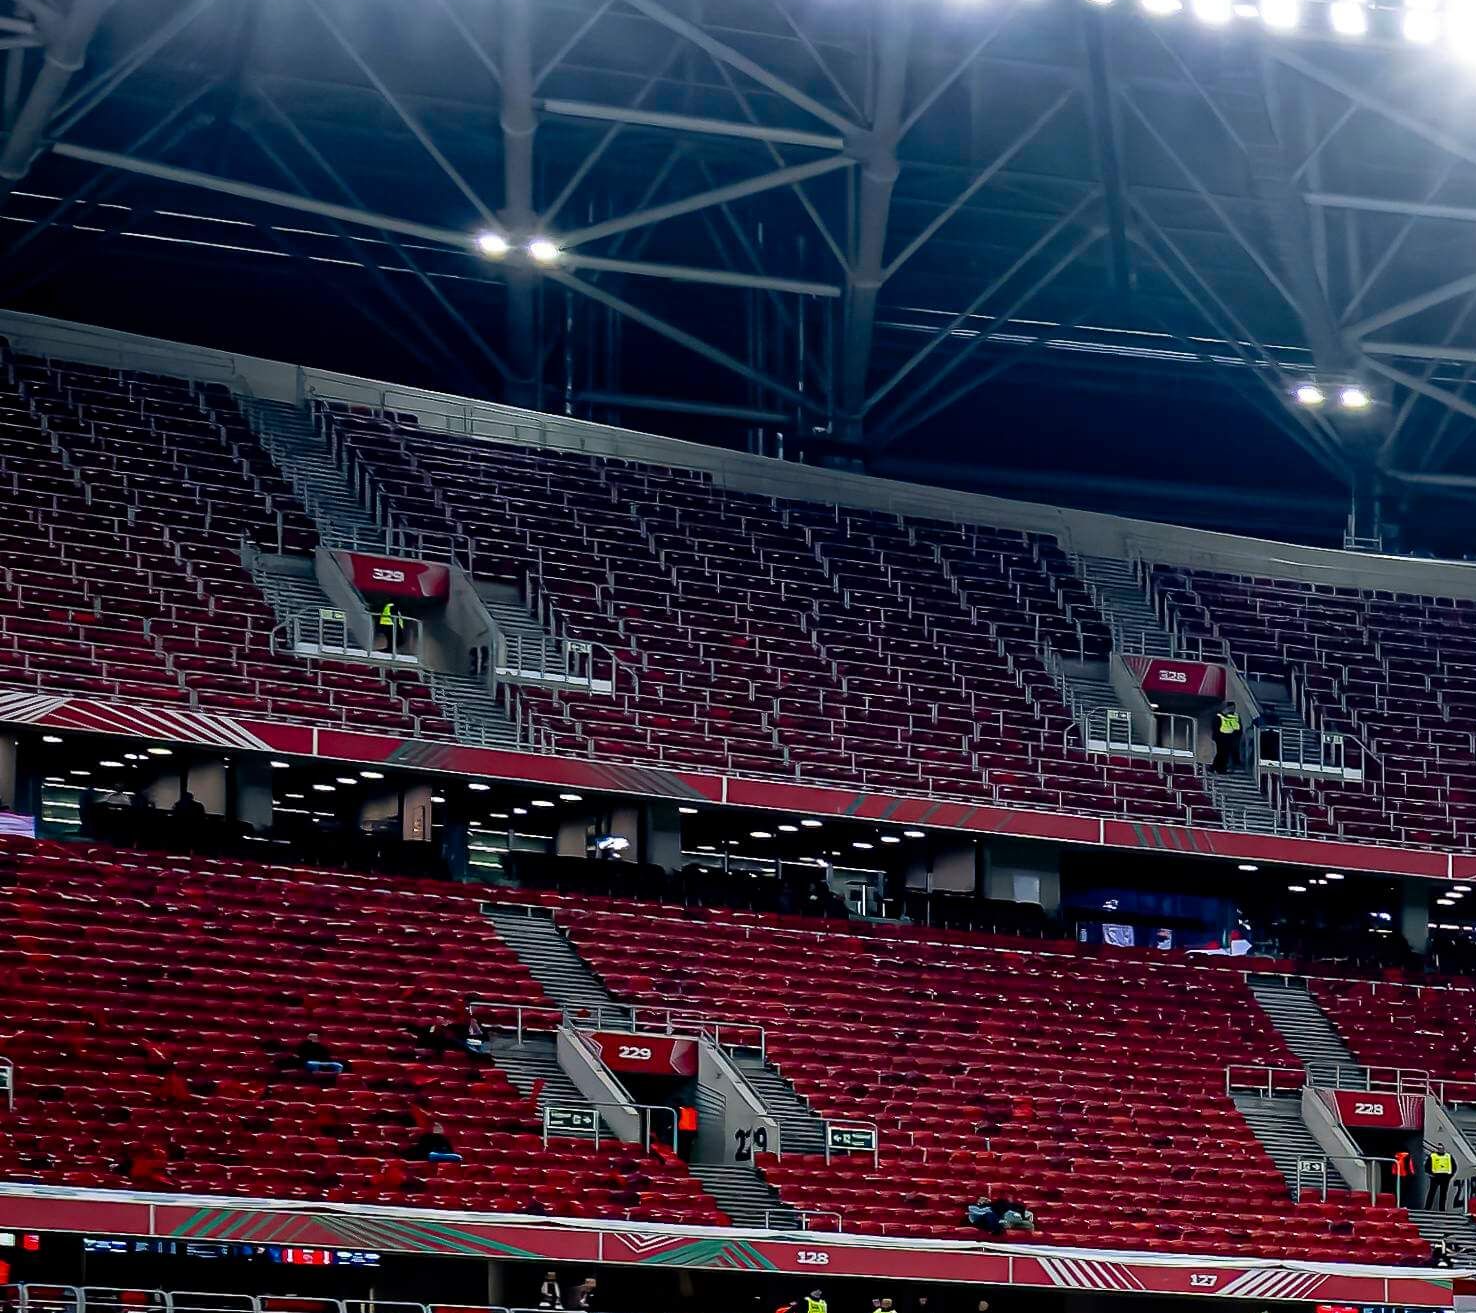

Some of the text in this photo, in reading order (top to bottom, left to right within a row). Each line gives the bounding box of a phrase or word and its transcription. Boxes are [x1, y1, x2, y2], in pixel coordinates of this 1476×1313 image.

[619, 1045, 651, 1060] 229
[1355, 1103, 1383, 1115] 228
[797, 1251, 829, 1266] 128
[1190, 1274, 1218, 1286] 127
